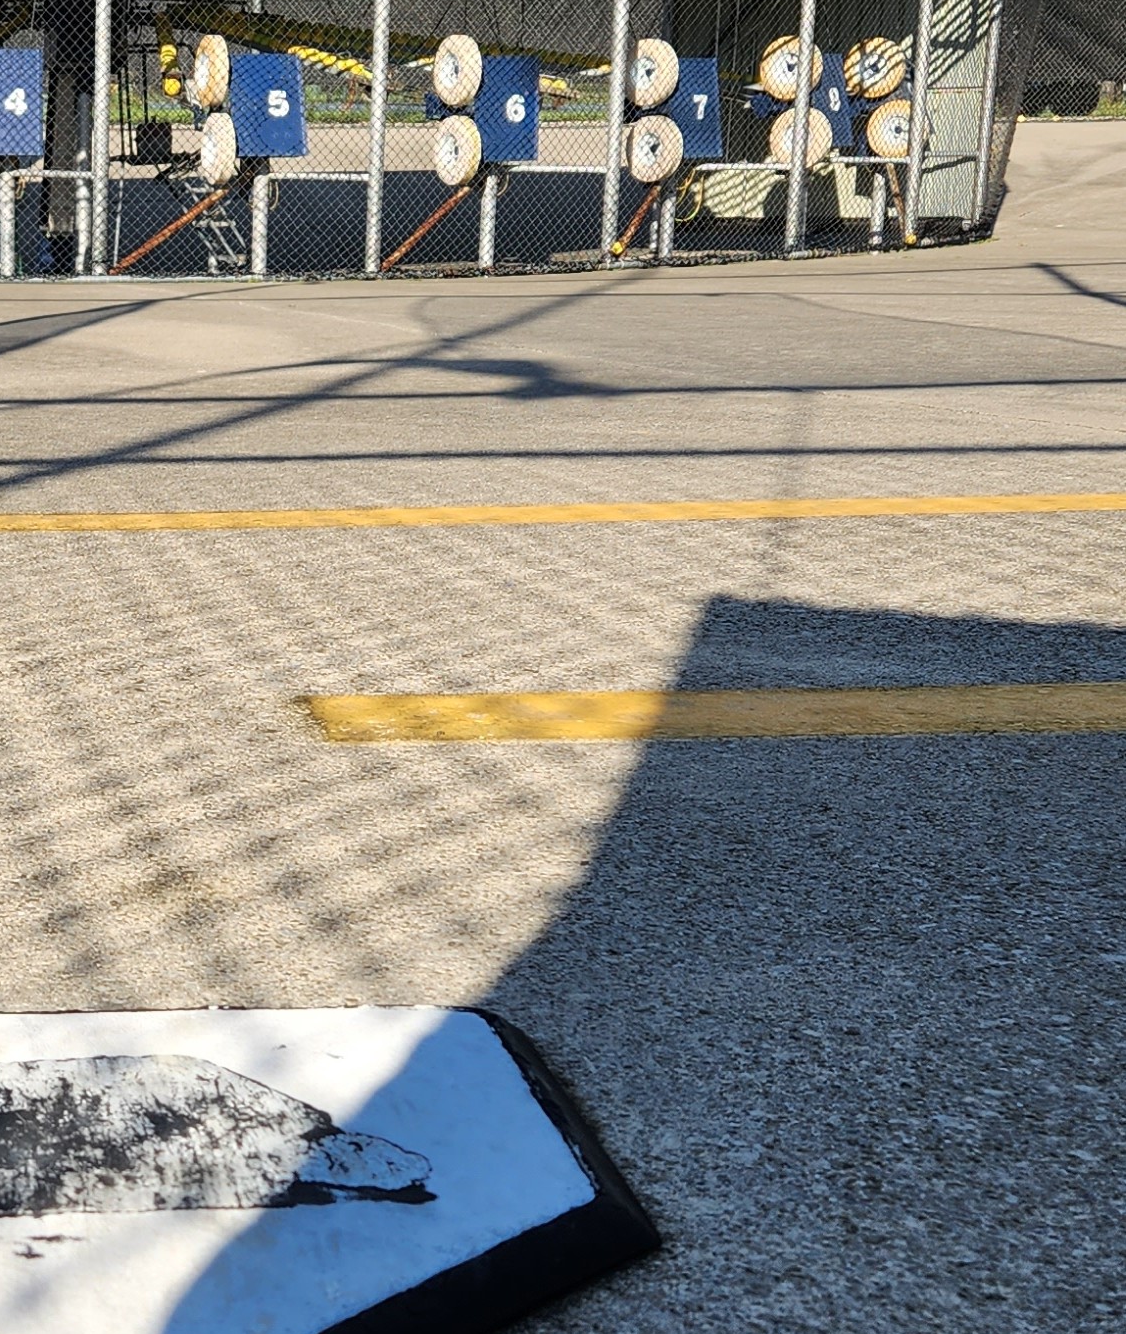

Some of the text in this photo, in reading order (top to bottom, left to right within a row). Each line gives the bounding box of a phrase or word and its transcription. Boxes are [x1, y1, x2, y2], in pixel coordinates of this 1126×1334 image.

[4, 88, 27, 115] 4
[268, 90, 289, 116] 5
[506, 94, 525, 122] 6
[693, 94, 708, 120] 7
